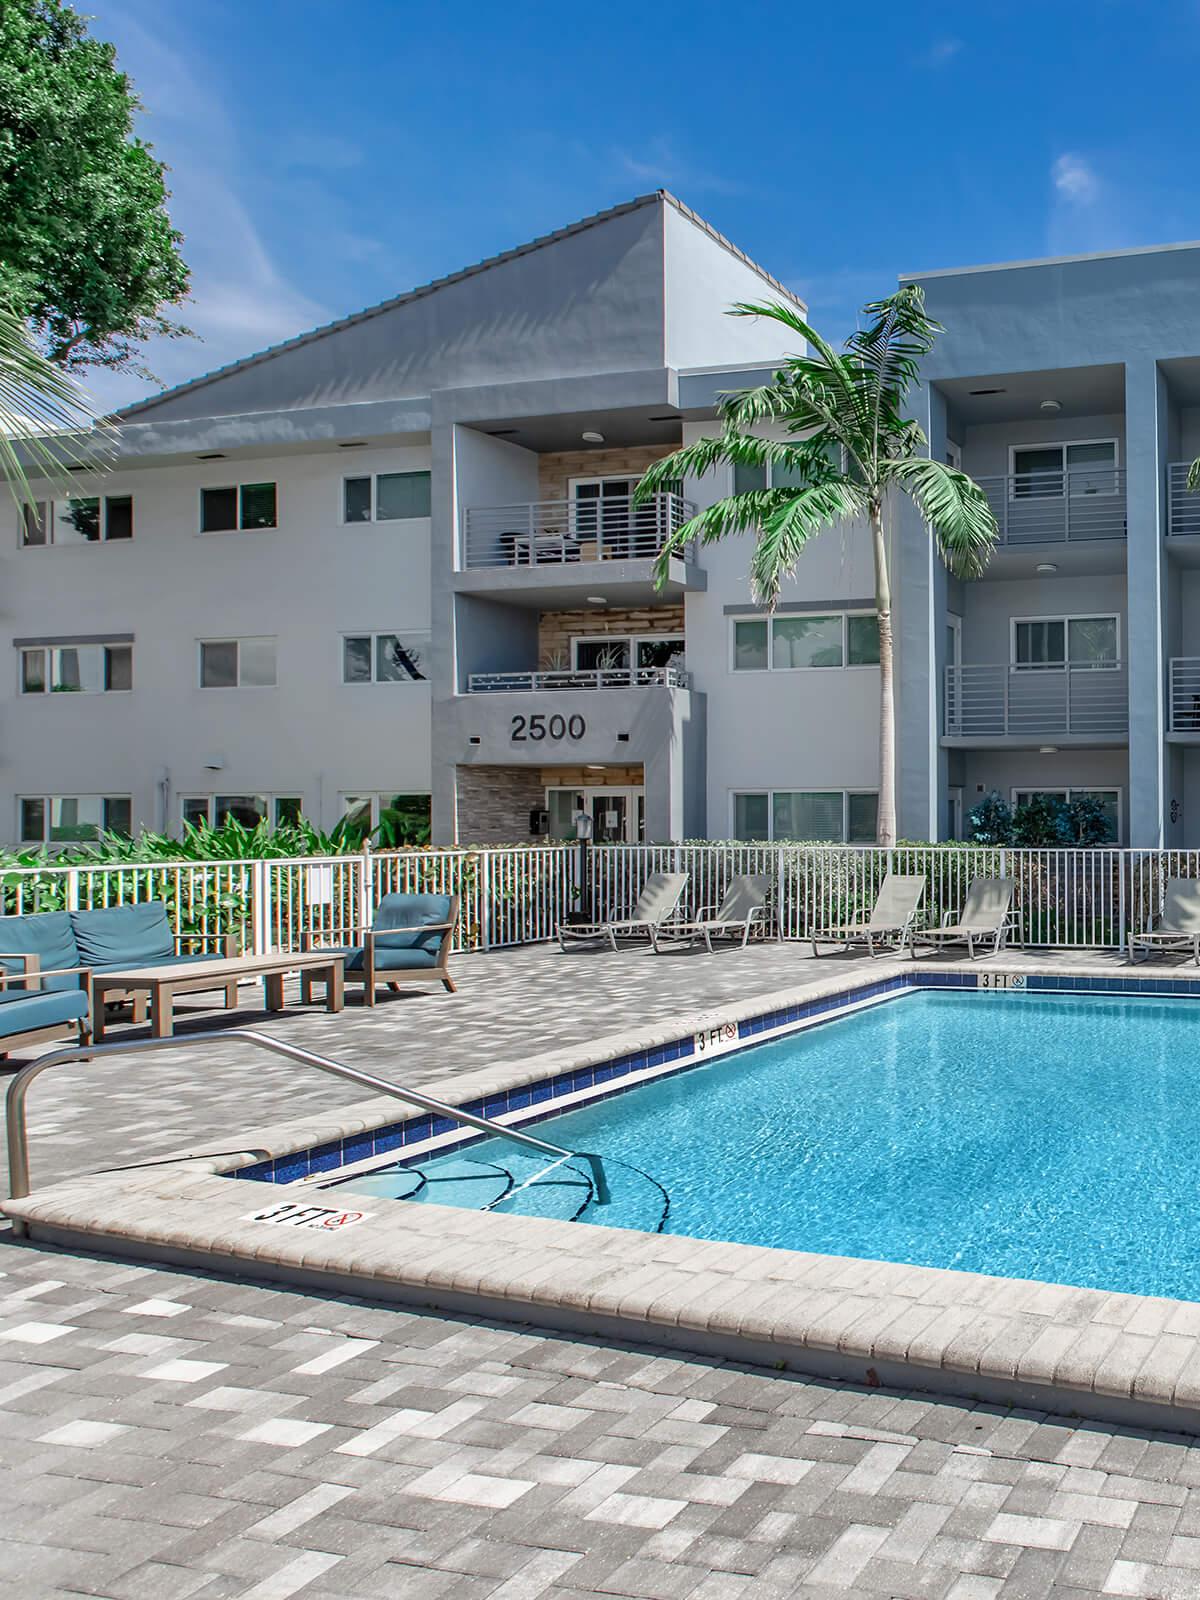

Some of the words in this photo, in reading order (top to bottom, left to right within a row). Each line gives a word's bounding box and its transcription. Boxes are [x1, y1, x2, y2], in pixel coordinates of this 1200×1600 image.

[511, 714, 586, 741] 2500
[983, 974, 990, 988] 3
[698, 1032, 706, 1051] 3
[254, 1204, 298, 1221] 3
[275, 1207, 339, 1226] FT
